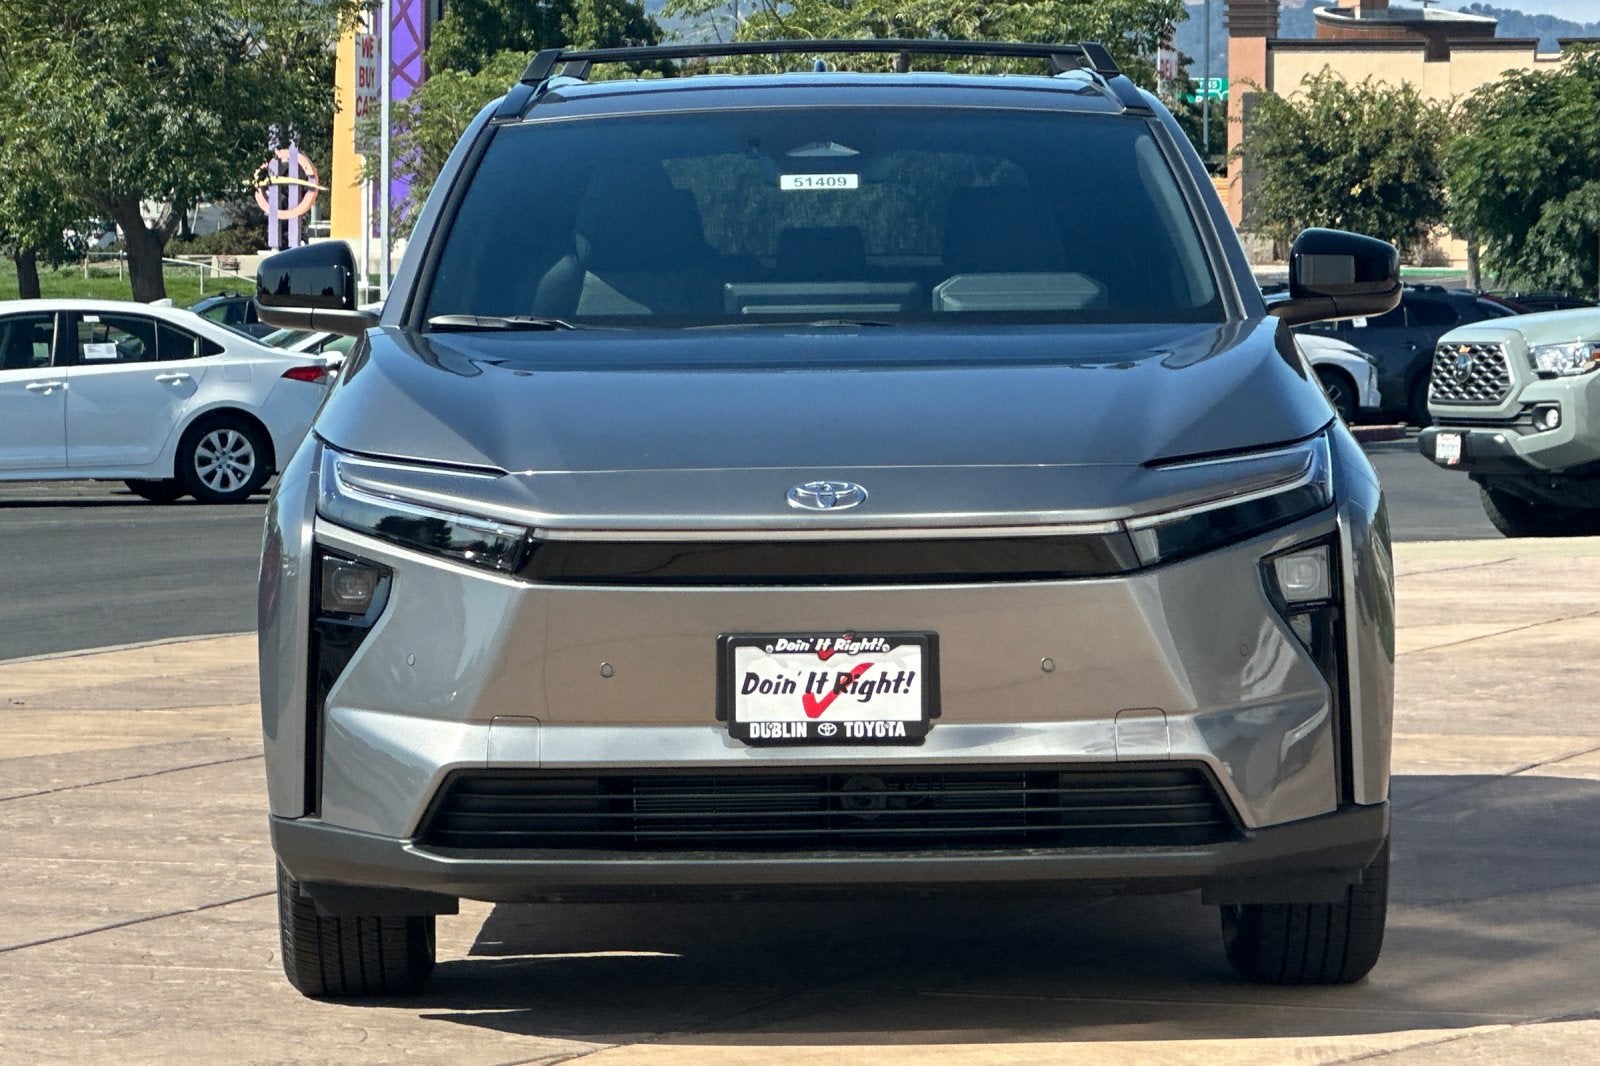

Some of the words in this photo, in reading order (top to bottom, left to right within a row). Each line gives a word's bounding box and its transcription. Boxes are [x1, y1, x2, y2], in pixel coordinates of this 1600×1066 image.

[361, 36, 374, 59] WE
[358, 66, 375, 89] BUY
[355, 95, 377, 118] CA
[793, 176, 848, 188] 51409
[774, 637, 814, 653] Doin'
[815, 637, 832, 652] It
[833, 637, 886, 656] Right!
[741, 670, 802, 695] Doin'
[804, 671, 830, 695] It
[832, 670, 916, 703] Right!
[749, 721, 808, 739] DUBLIN
[843, 720, 907, 738] TOYOTA
